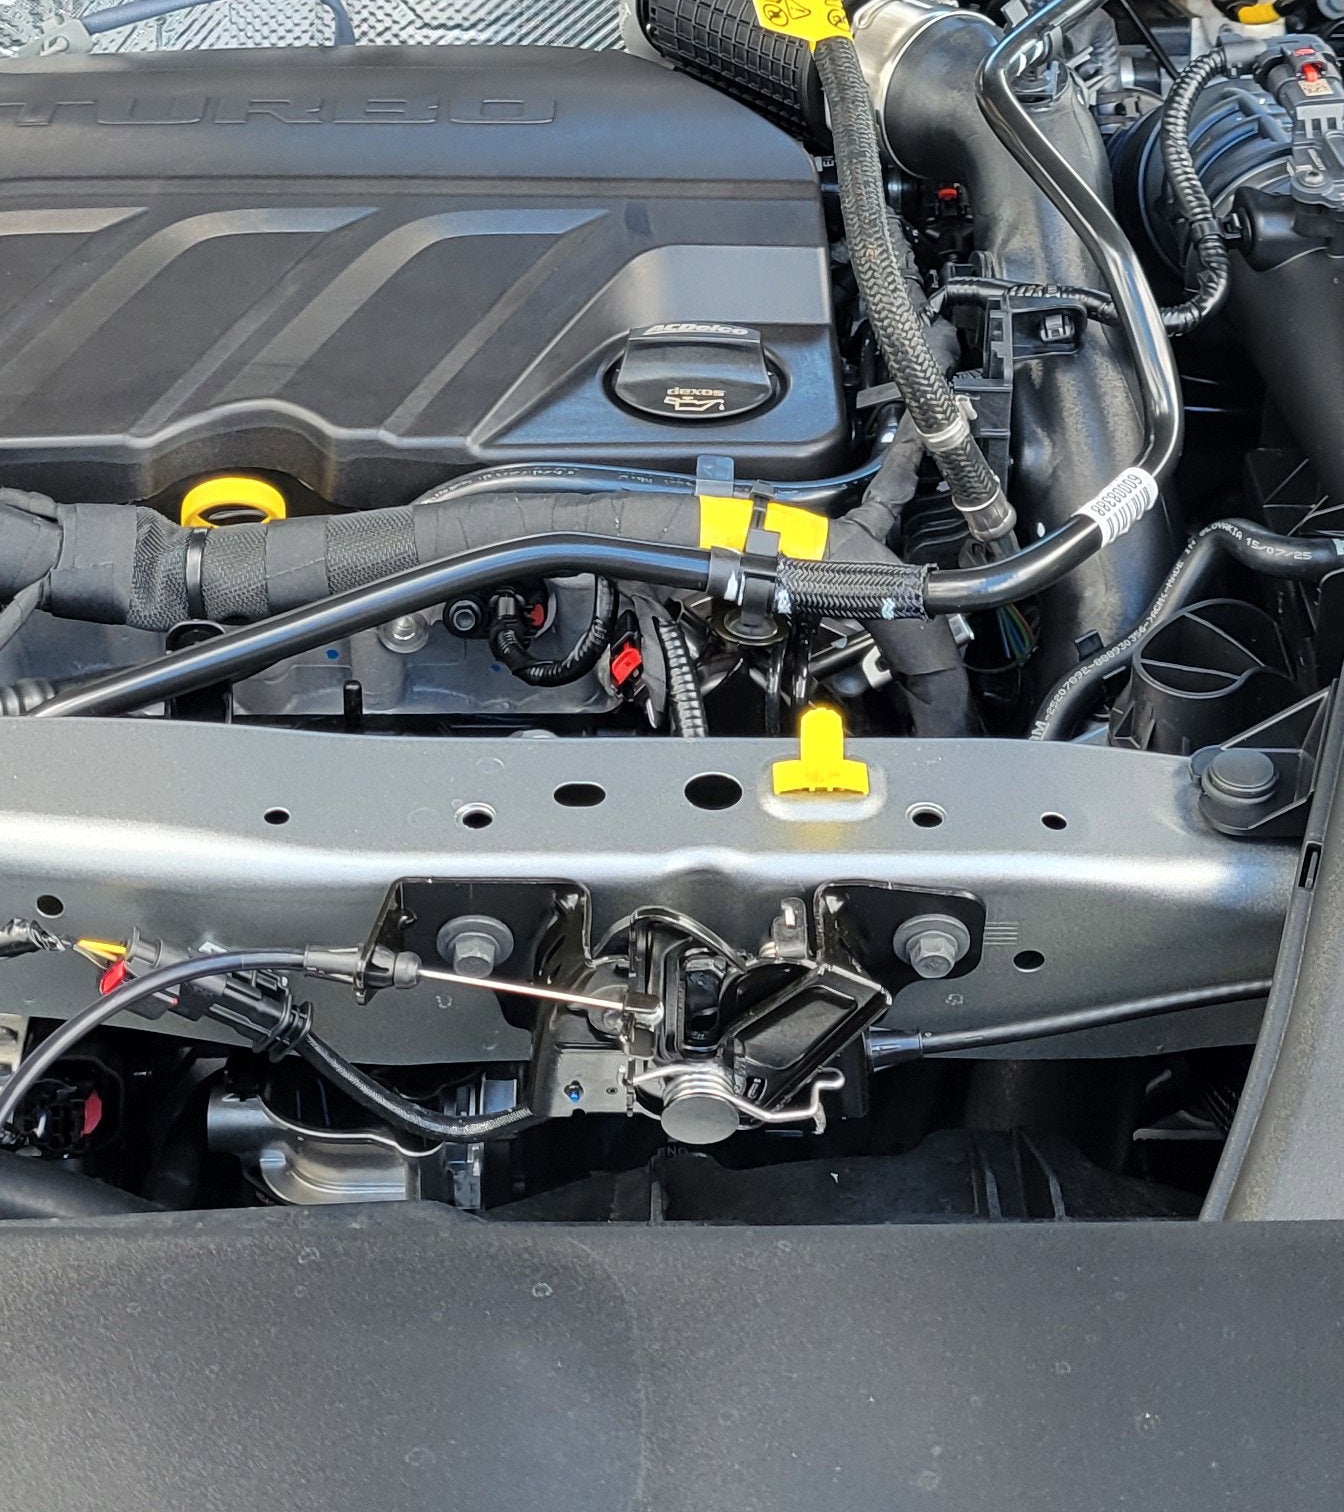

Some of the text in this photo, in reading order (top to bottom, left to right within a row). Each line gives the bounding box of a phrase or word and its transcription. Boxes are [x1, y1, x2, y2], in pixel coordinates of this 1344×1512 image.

[642, 323, 749, 336] ACDelco
[666, 387, 726, 397] dexos
[1090, 474, 1143, 517] 60008388
[1246, 537, 1313, 560] 15/07/25
